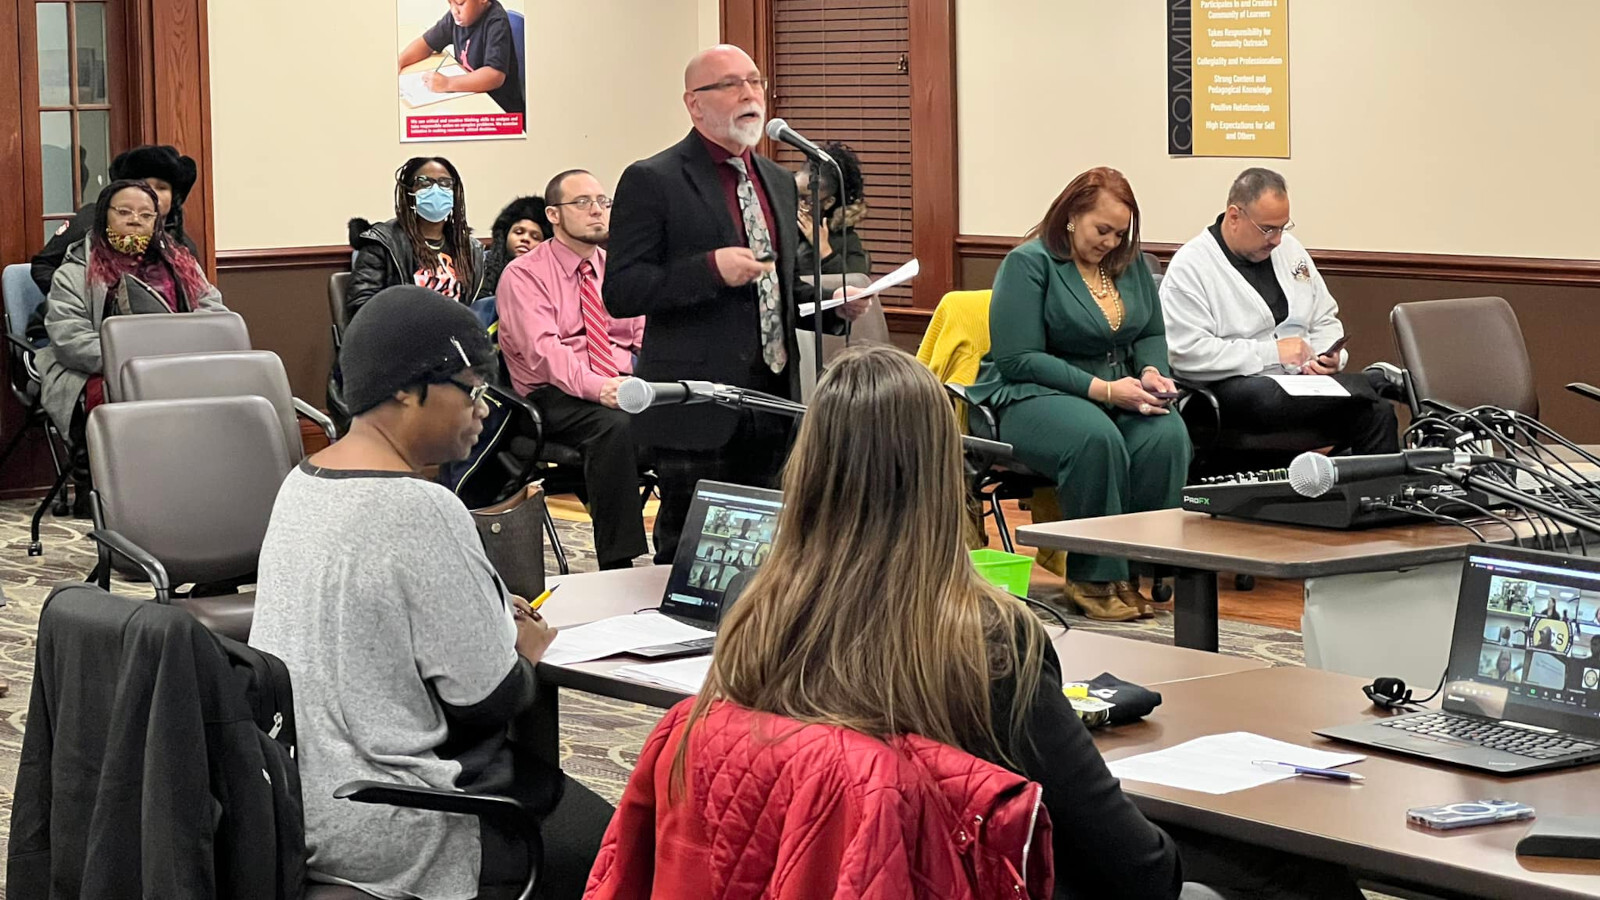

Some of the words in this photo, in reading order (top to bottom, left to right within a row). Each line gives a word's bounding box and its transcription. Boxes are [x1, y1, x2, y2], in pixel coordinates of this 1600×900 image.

[1200, 0, 1232, 8] Participates
[1208, 11, 1238, 19] Community
[1224, 28, 1262, 37] Responsibility
[1211, 39, 1242, 48] Community
[1197, 57, 1227, 66] Collegiality
[1214, 75, 1232, 84] Strong
[1208, 86, 1241, 94] Pedagogical
[1242, 86, 1272, 94] Knowledge
[1211, 103, 1232, 111] Positive
[1233, 104, 1269, 112] Relationships
[1206, 121, 1218, 130] High
[1220, 121, 1254, 130] Expectations
